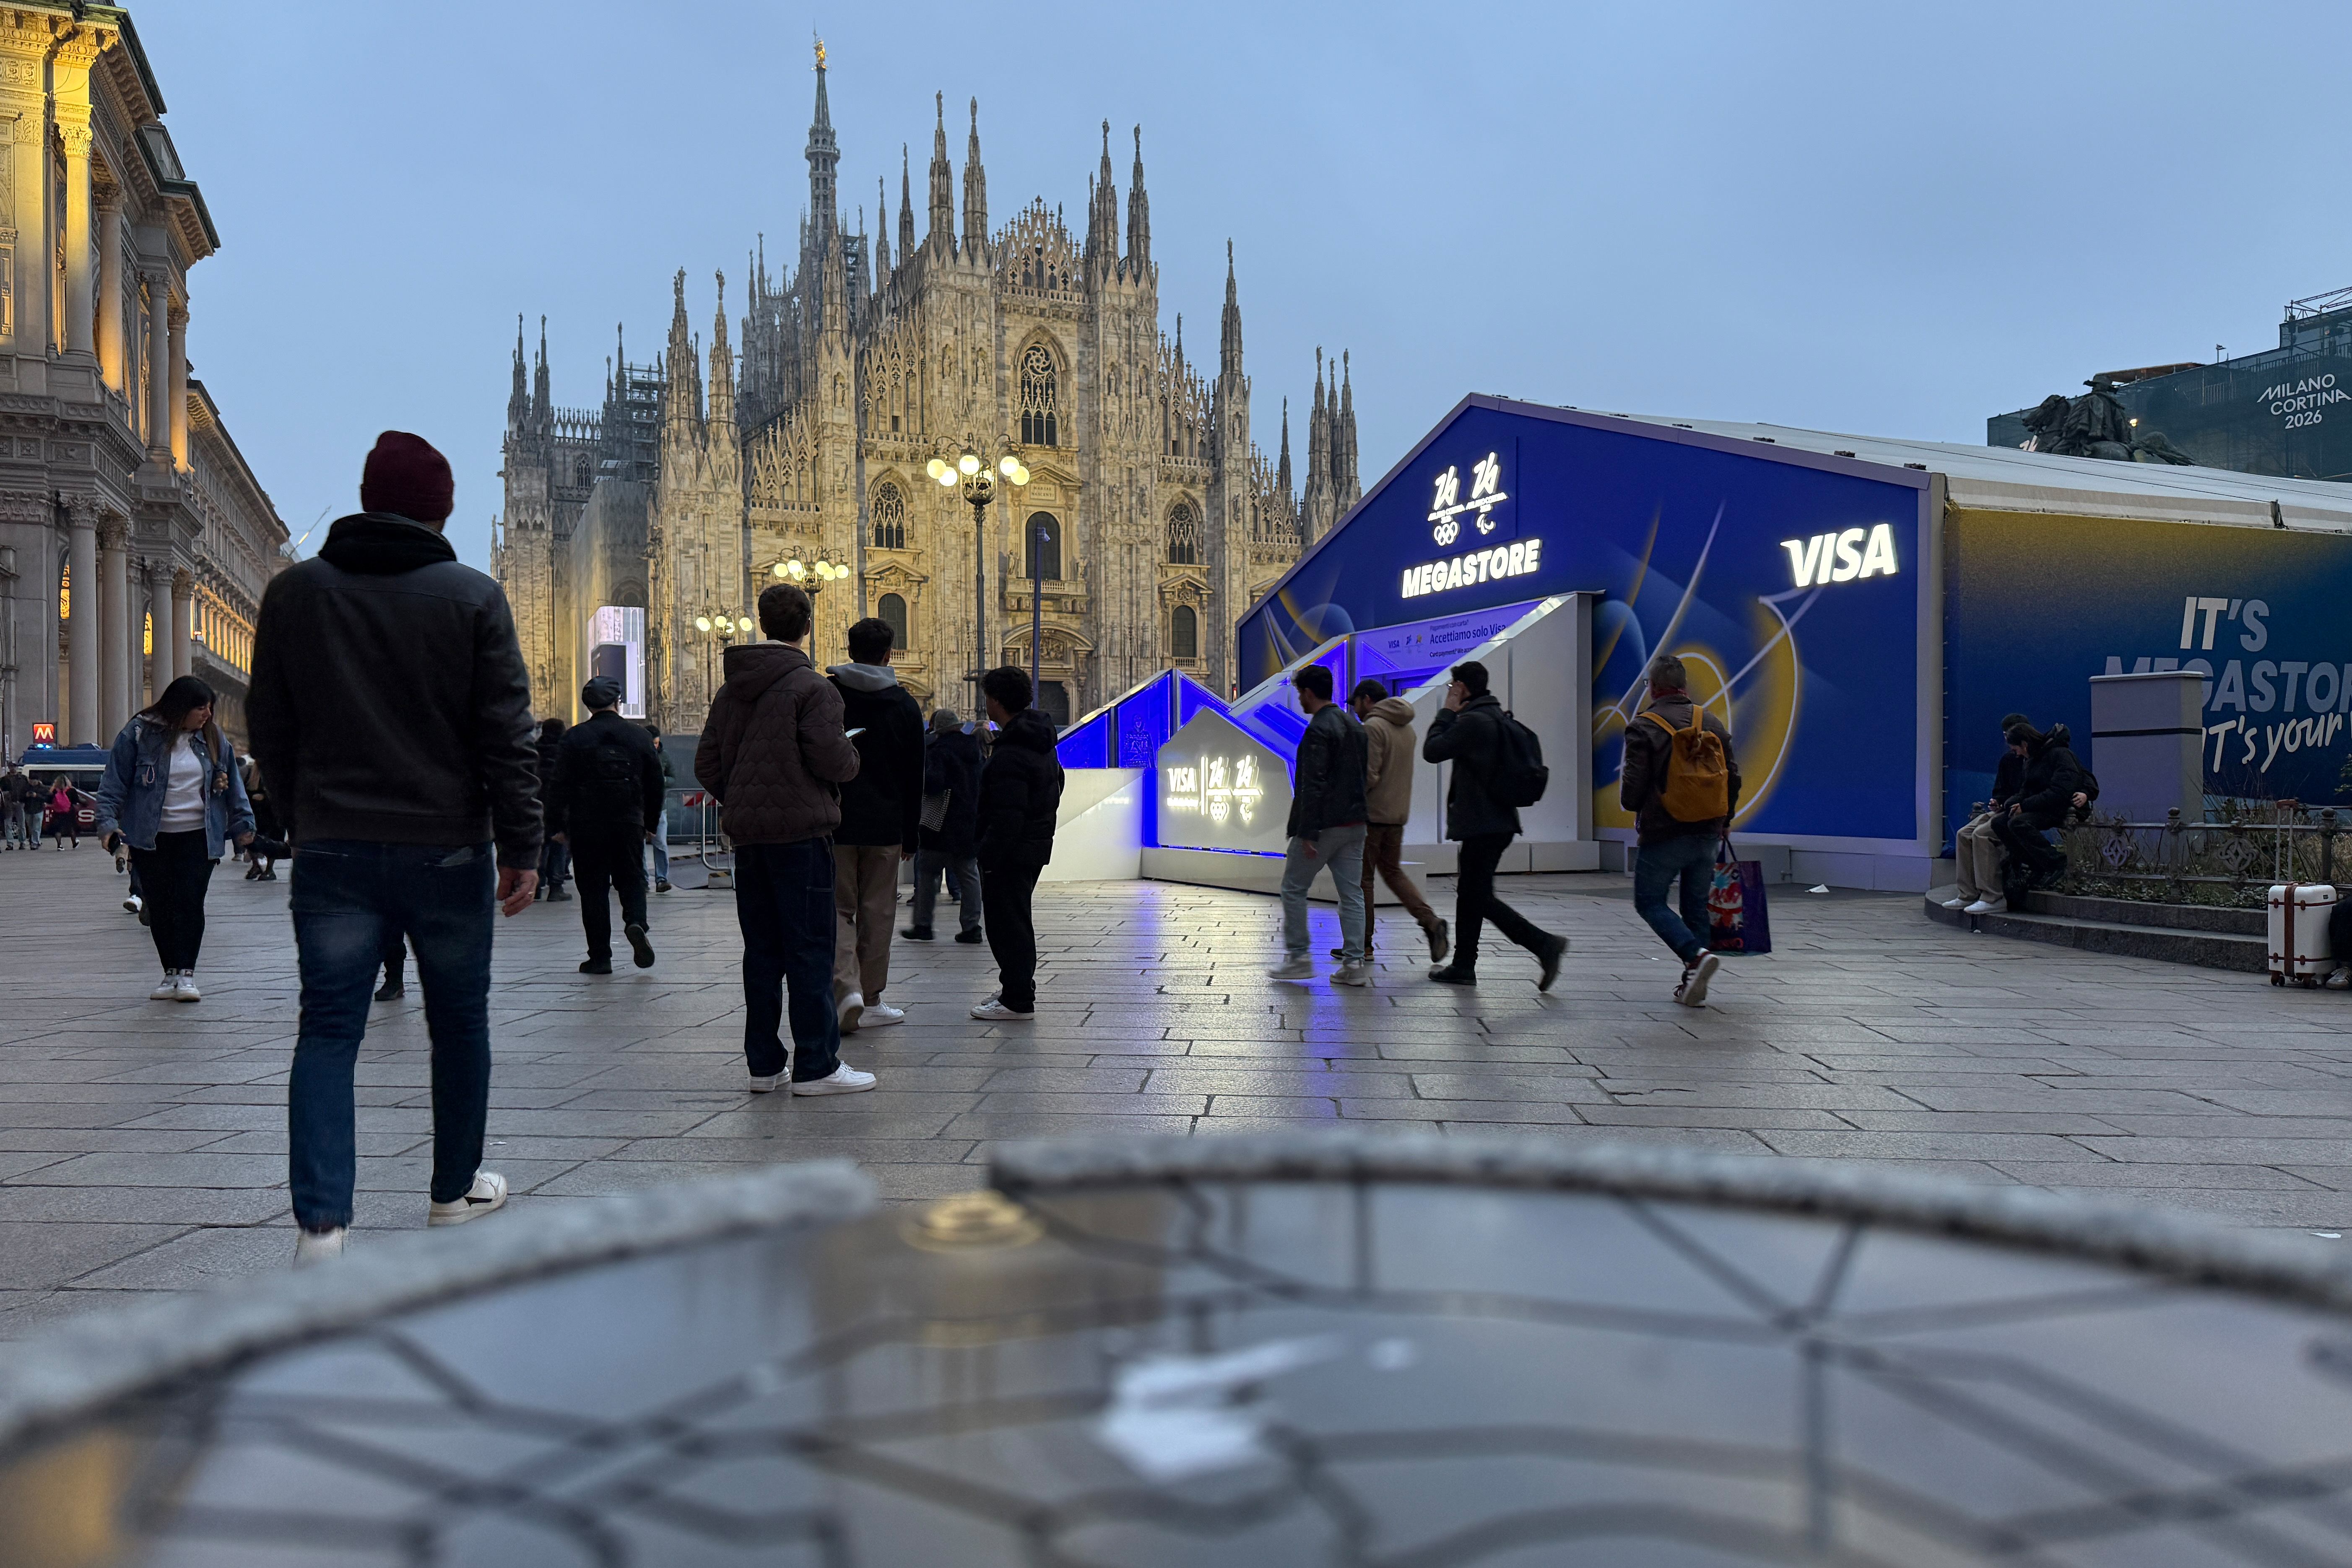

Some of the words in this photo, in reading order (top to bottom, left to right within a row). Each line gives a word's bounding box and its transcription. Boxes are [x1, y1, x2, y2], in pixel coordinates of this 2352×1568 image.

[2257, 374, 2335, 403] MILANO
[2271, 389, 2352, 415] CORTINA
[2285, 410, 2322, 429] 2026
[1780, 523, 1897, 587] VISA
[1402, 538, 1541, 599] MEGASTORE
[1430, 630, 1471, 644] Accettiamo
[1472, 625, 1488, 638] solo
[2180, 597, 2269, 652] IT'S
[1388, 640, 1400, 648] VISA
[35, 727, 54, 739] M
[2261, 712, 2342, 773] your
[1167, 767, 1195, 792] VISA
